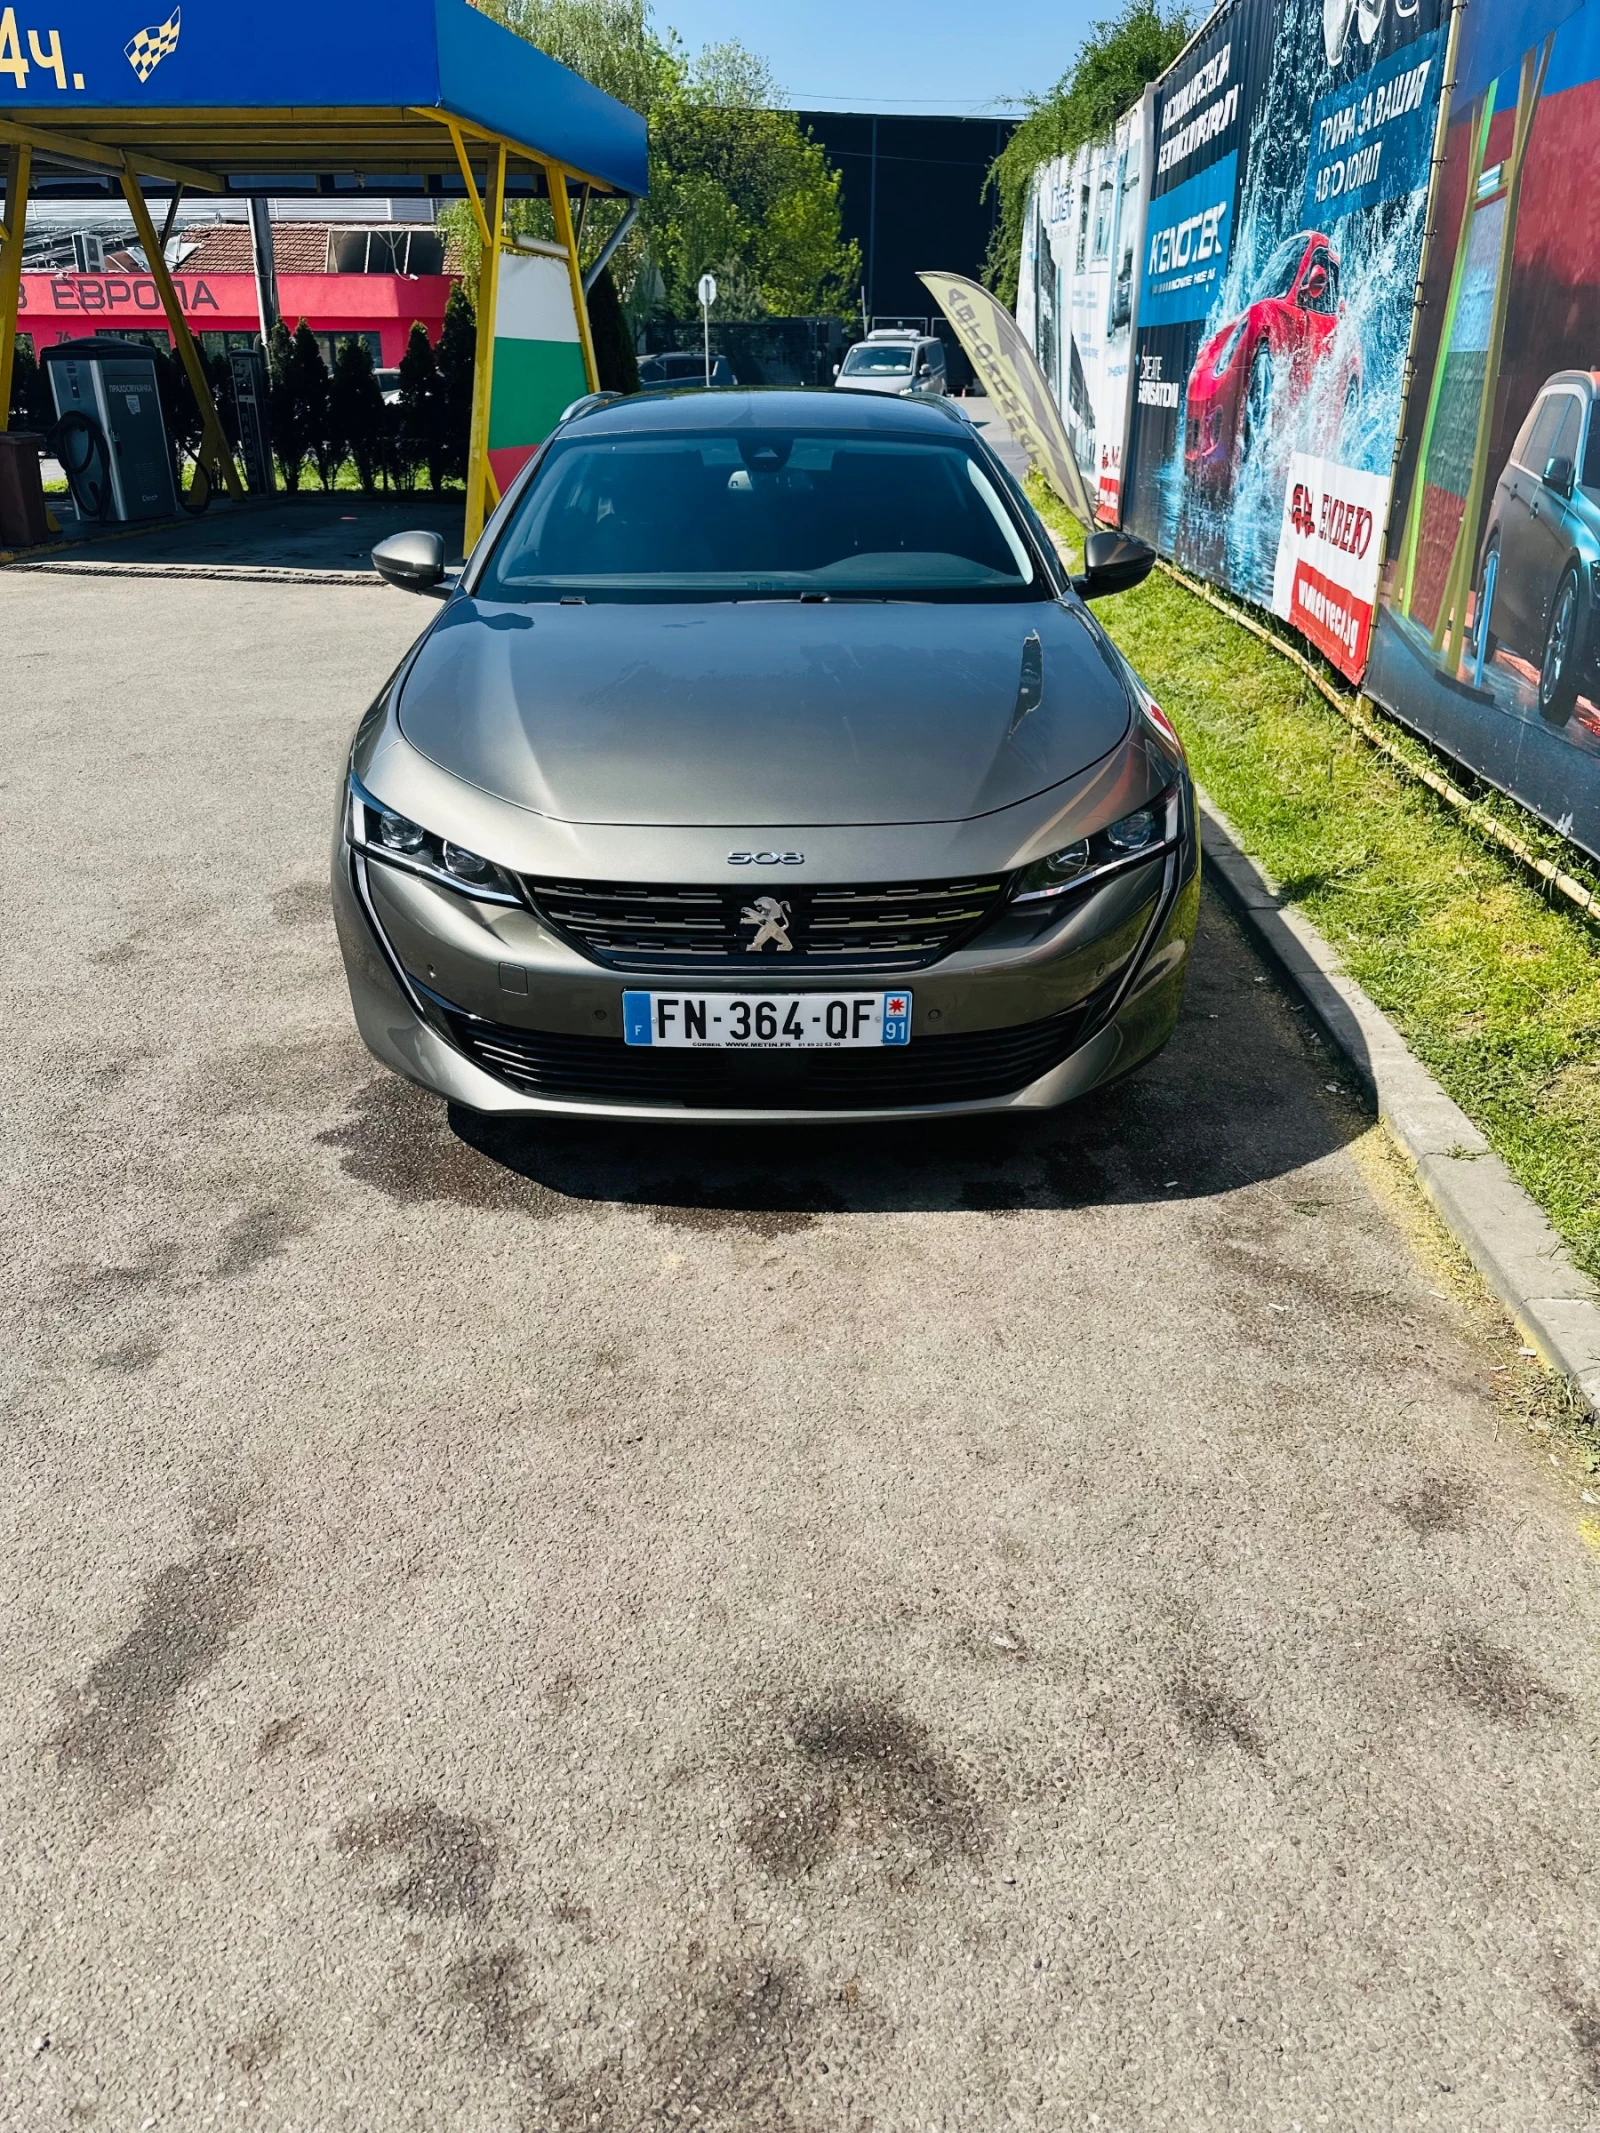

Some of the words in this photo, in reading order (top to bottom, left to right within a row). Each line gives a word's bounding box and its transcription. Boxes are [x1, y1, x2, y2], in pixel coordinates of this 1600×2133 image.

[1318, 102, 1356, 155] ГРИЖА
[1357, 92, 1373, 136] ЗА
[1373, 60, 1431, 128] ВАШИЯ
[50, 280, 219, 310] ЕВРОПА
[108, 384, 153, 393] ПРАХОСМУКАЧКА
[727, 851, 805, 865] 508
[634, 1025, 643, 1036] F
[657, 999, 875, 1040] FN-364-QF
[885, 1022, 906, 1040] 91
